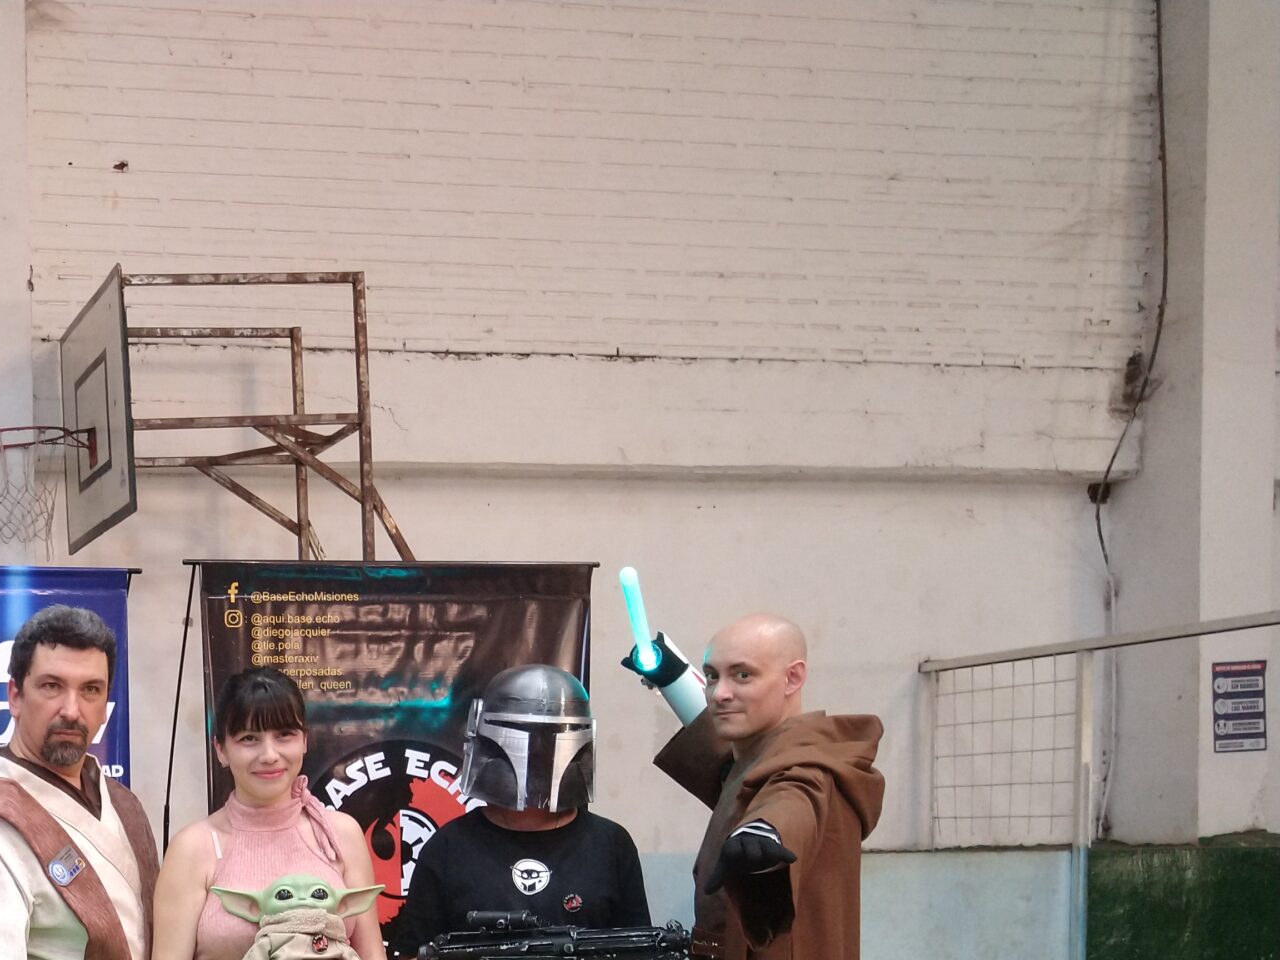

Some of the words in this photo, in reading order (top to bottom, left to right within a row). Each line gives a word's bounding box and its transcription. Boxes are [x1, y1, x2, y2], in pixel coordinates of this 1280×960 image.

[250, 591, 360, 604] @BaseEchoMisiones
[251, 613, 341, 626] @aqui.base.echo
[251, 654, 320, 666] @masteraxiv
[321, 751, 391, 812] ASE
